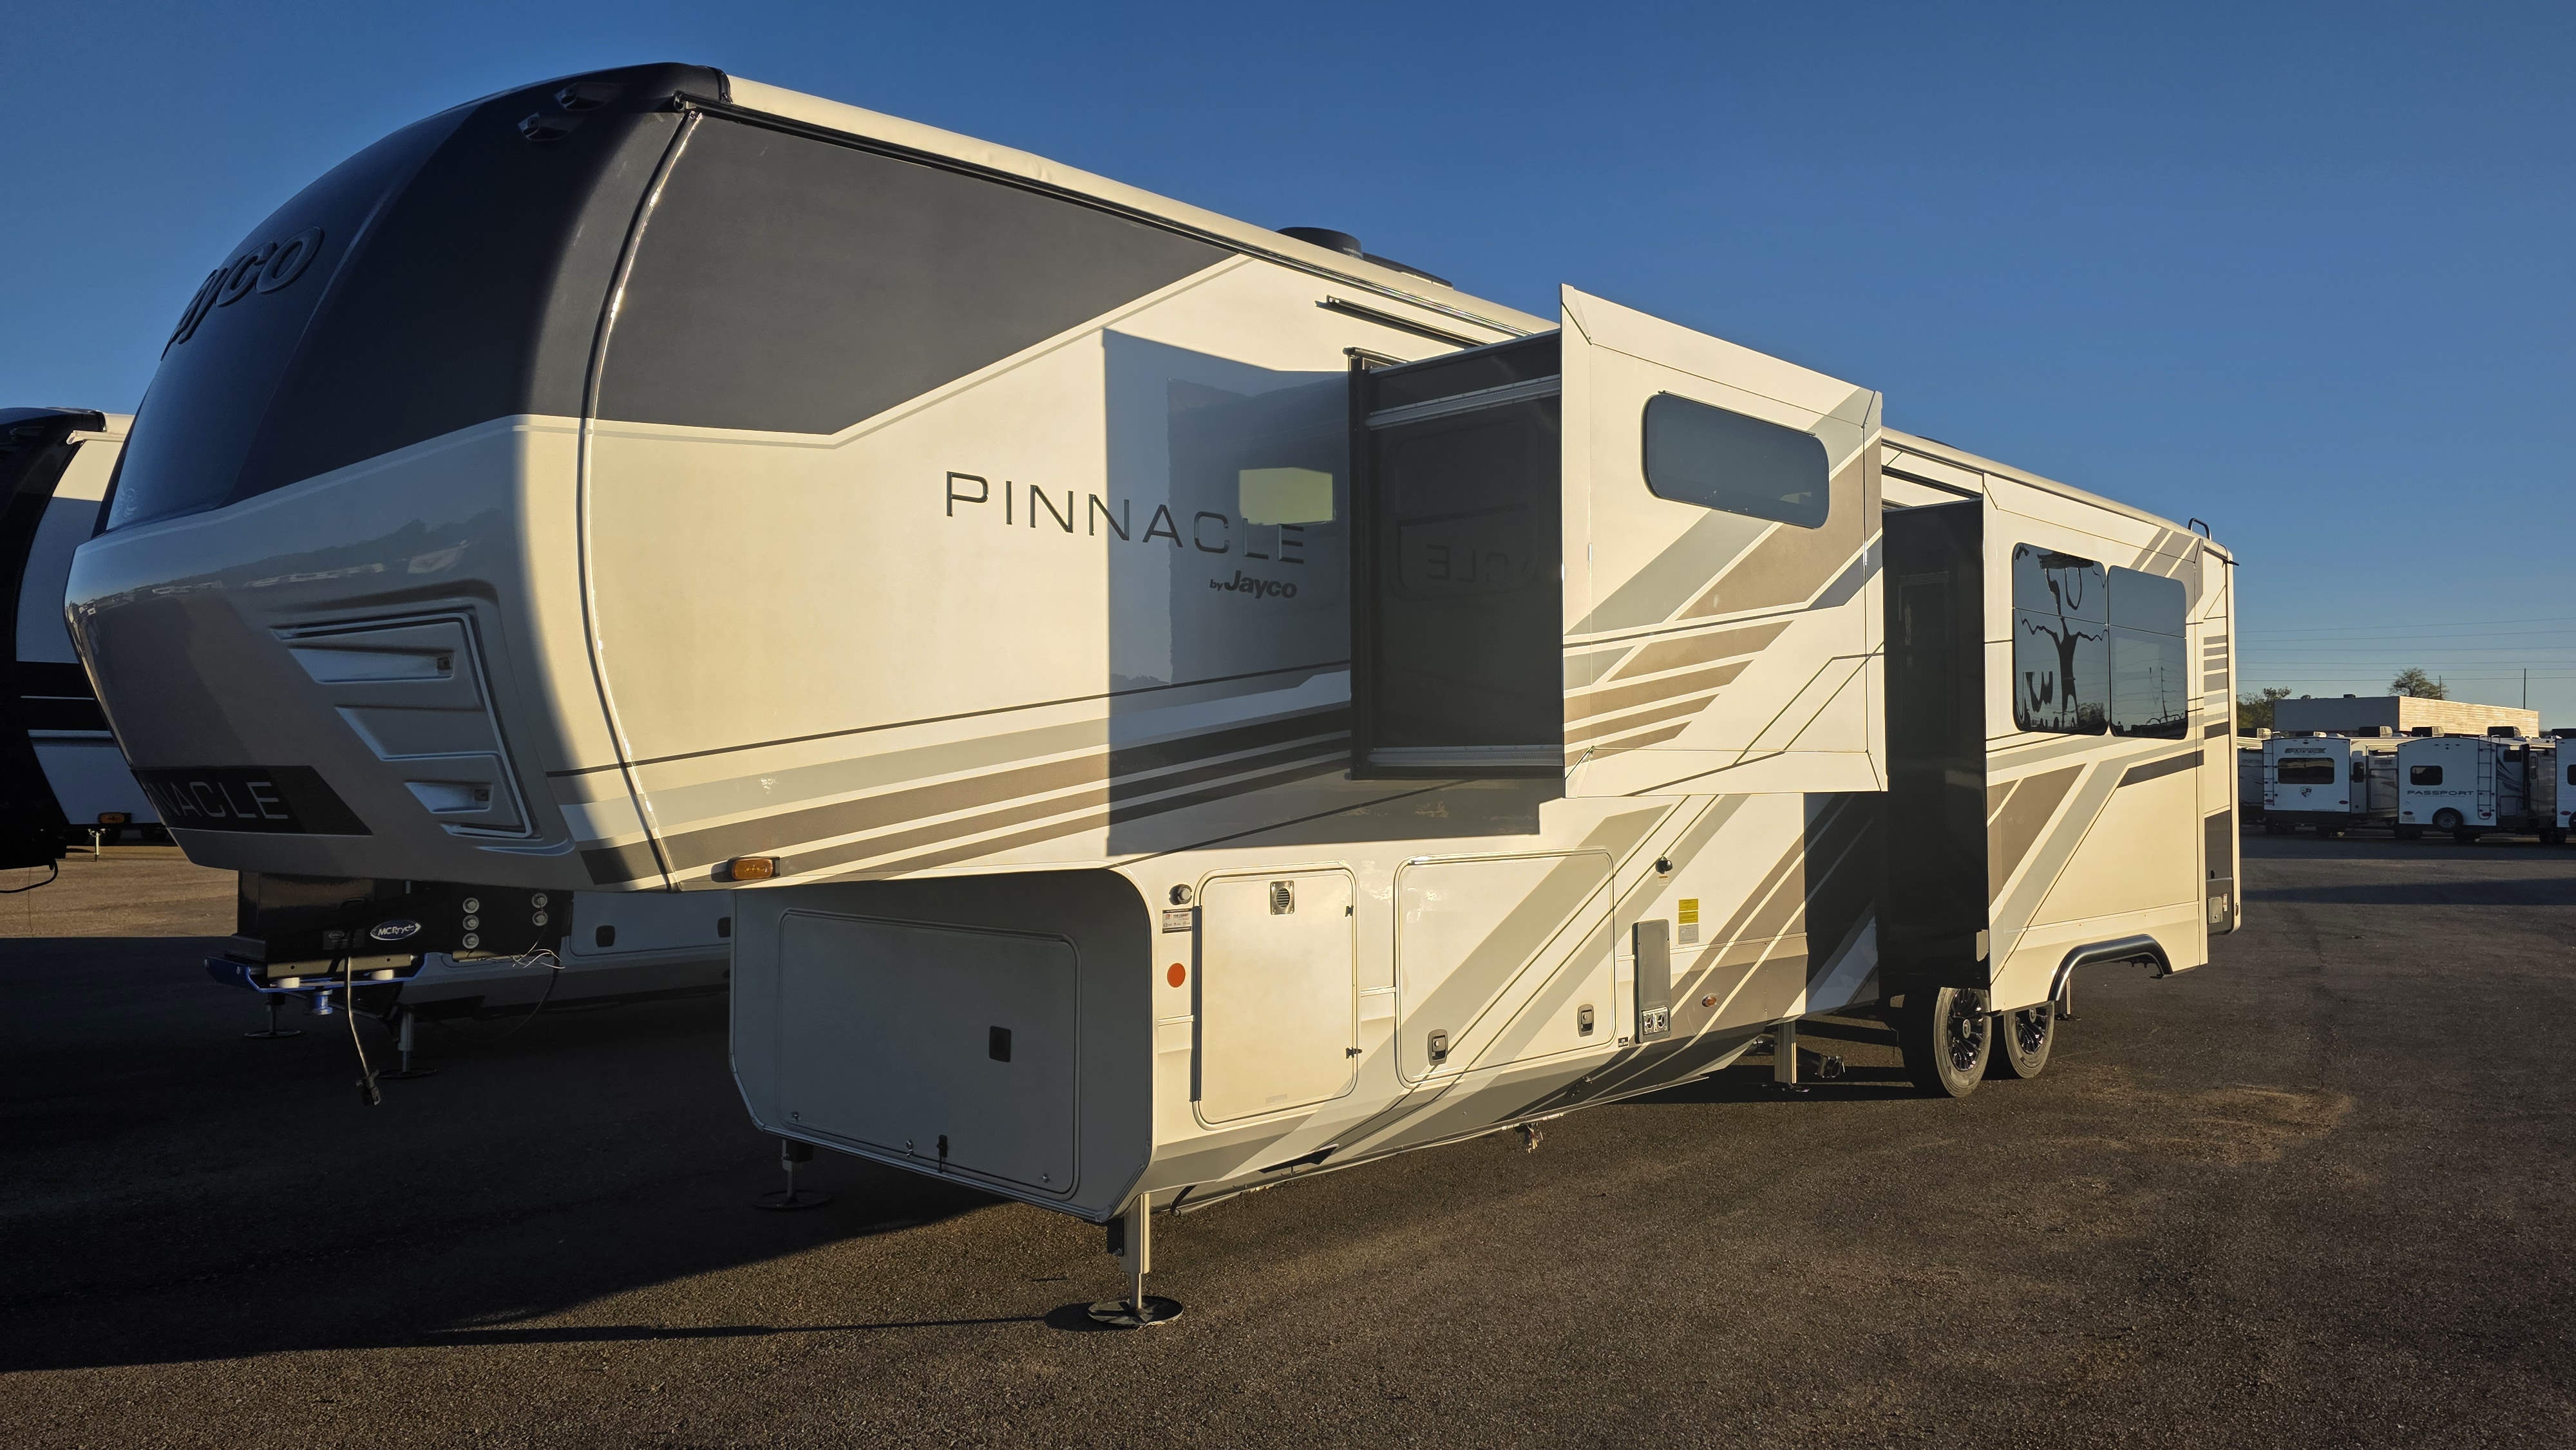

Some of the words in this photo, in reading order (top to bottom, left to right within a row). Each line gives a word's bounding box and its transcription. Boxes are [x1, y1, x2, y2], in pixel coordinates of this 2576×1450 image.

[946, 471, 1305, 565] PINNACLE
[1209, 579, 1223, 591] by
[1224, 570, 1297, 599] Jayco
